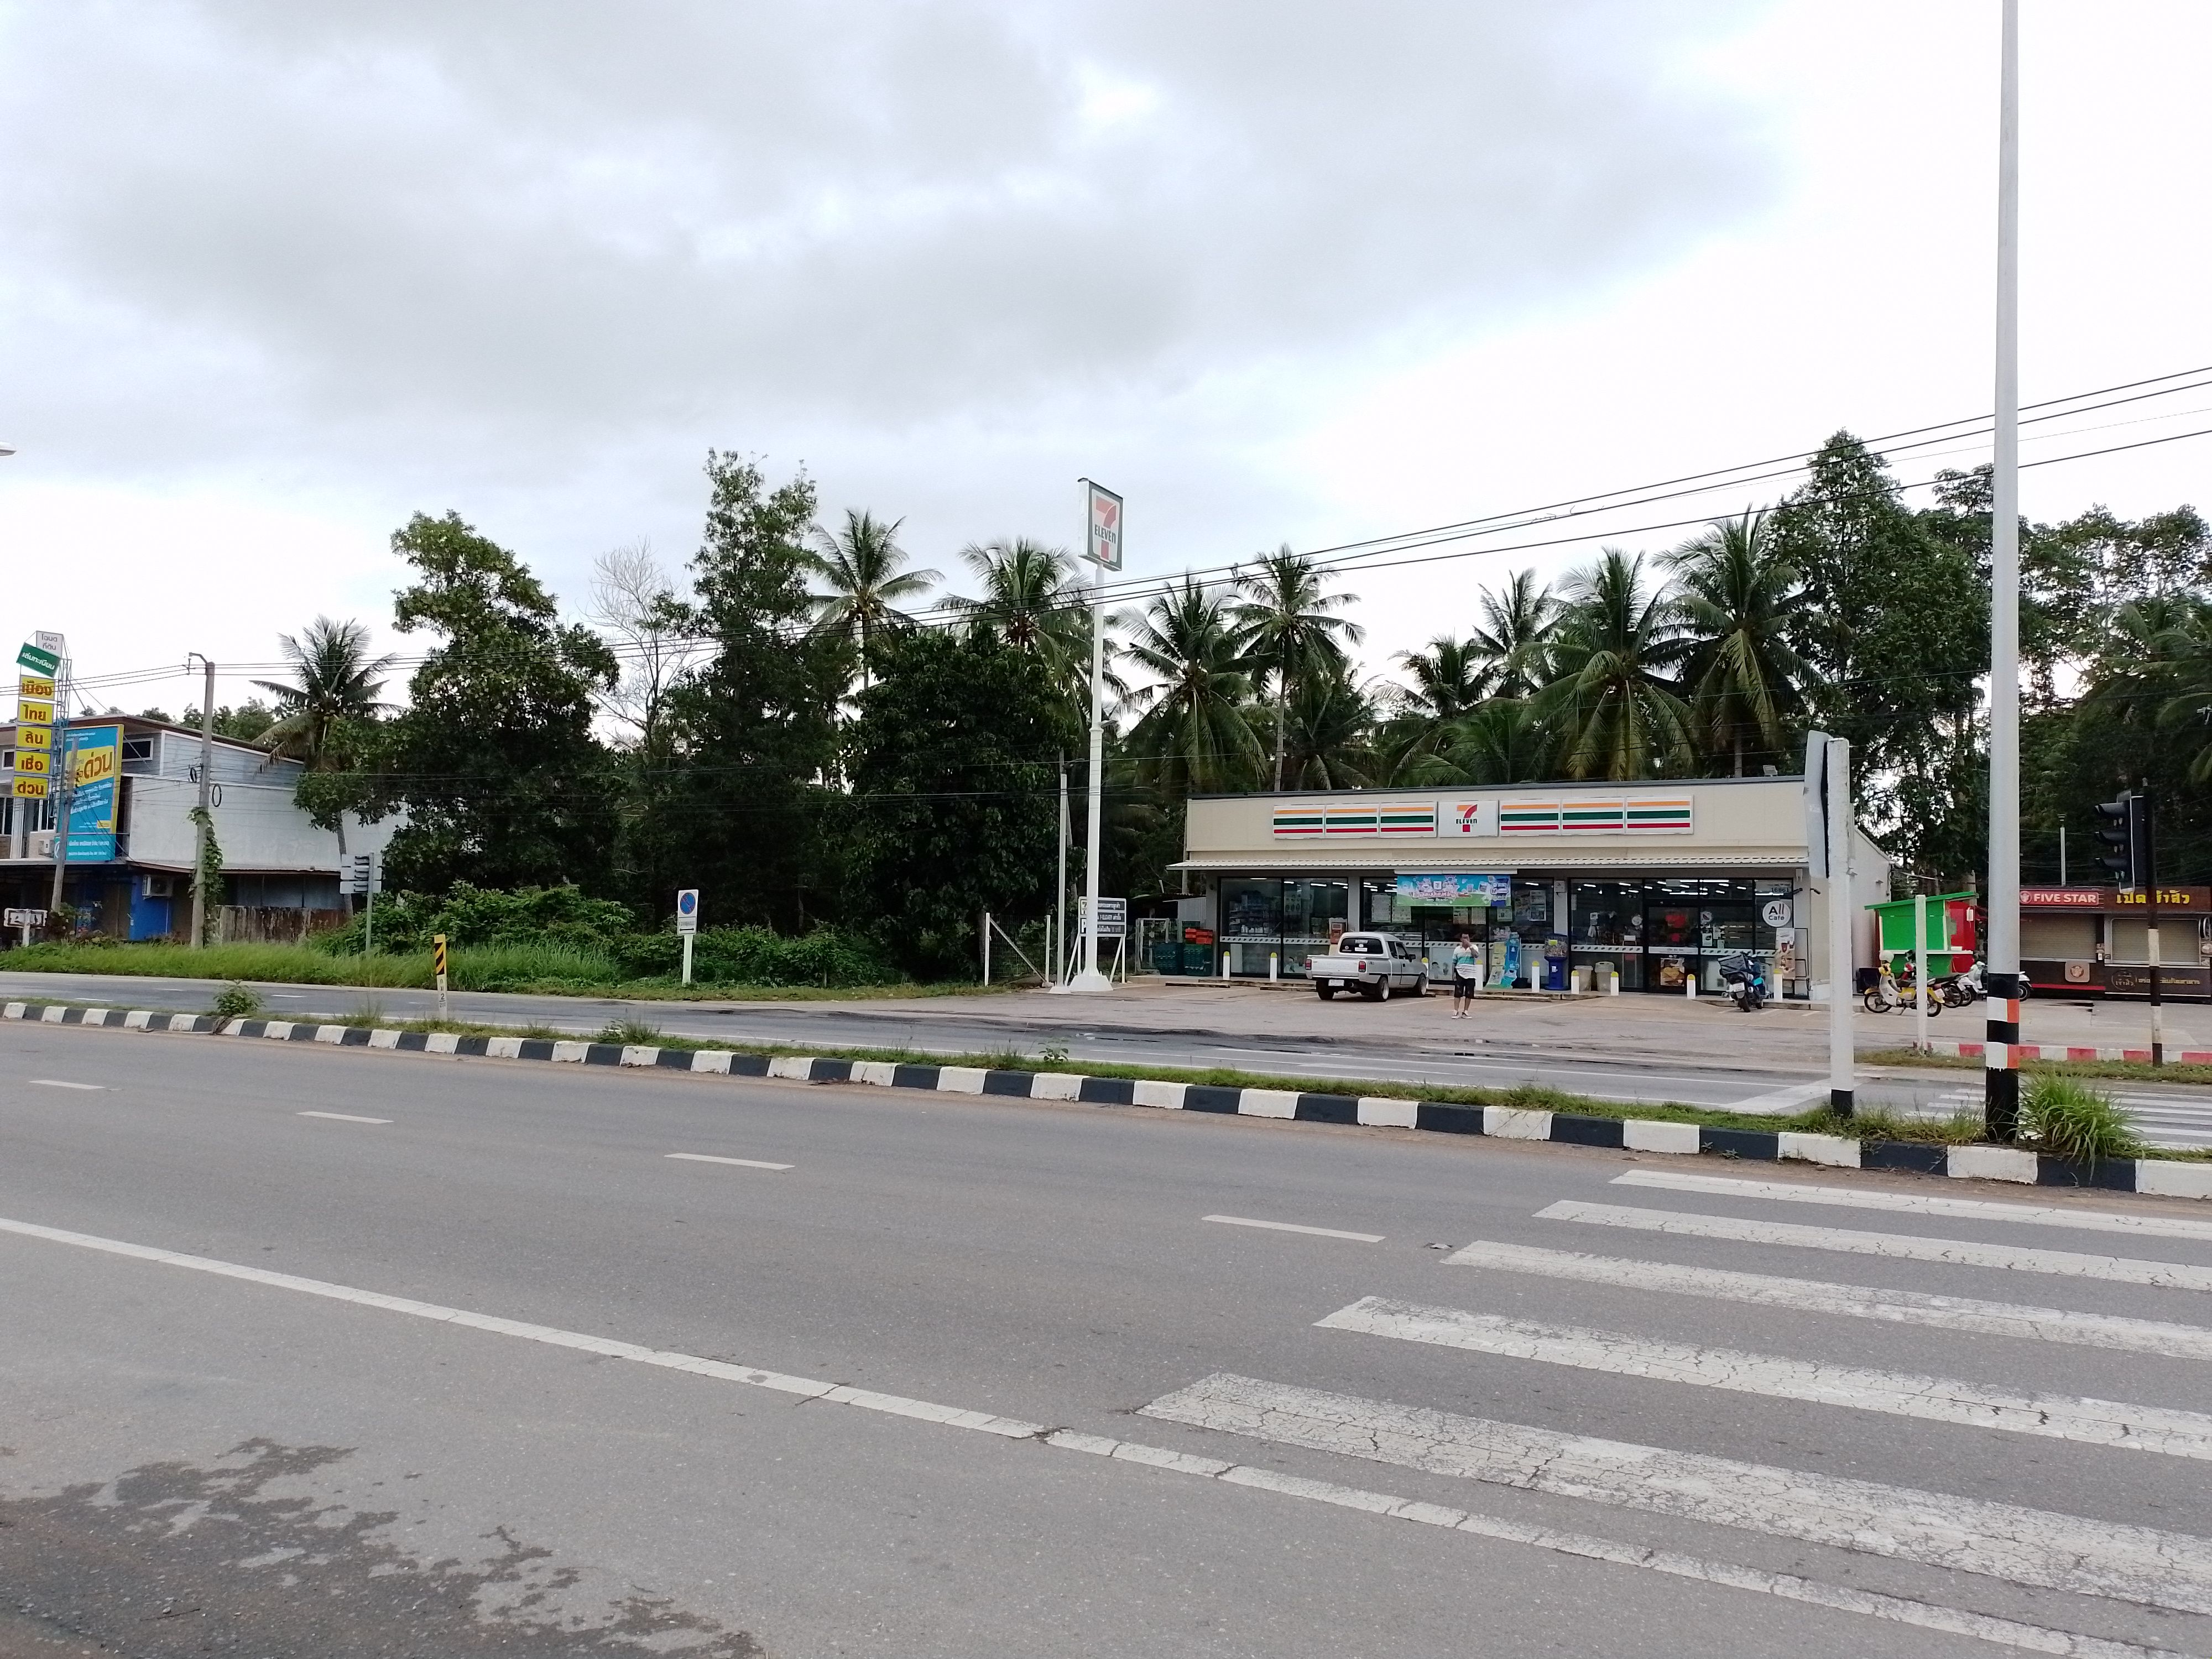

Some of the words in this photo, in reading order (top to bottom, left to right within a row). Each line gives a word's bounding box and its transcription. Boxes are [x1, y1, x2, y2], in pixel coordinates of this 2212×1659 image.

[23, 704, 46, 721] ไทย
[25, 731, 44, 745] สิน
[83, 751, 113, 779] ด่วน
[17, 781, 44, 795] ด่วน
[2033, 893, 2061, 902] FIVE
[2063, 894, 2097, 904] STAR
